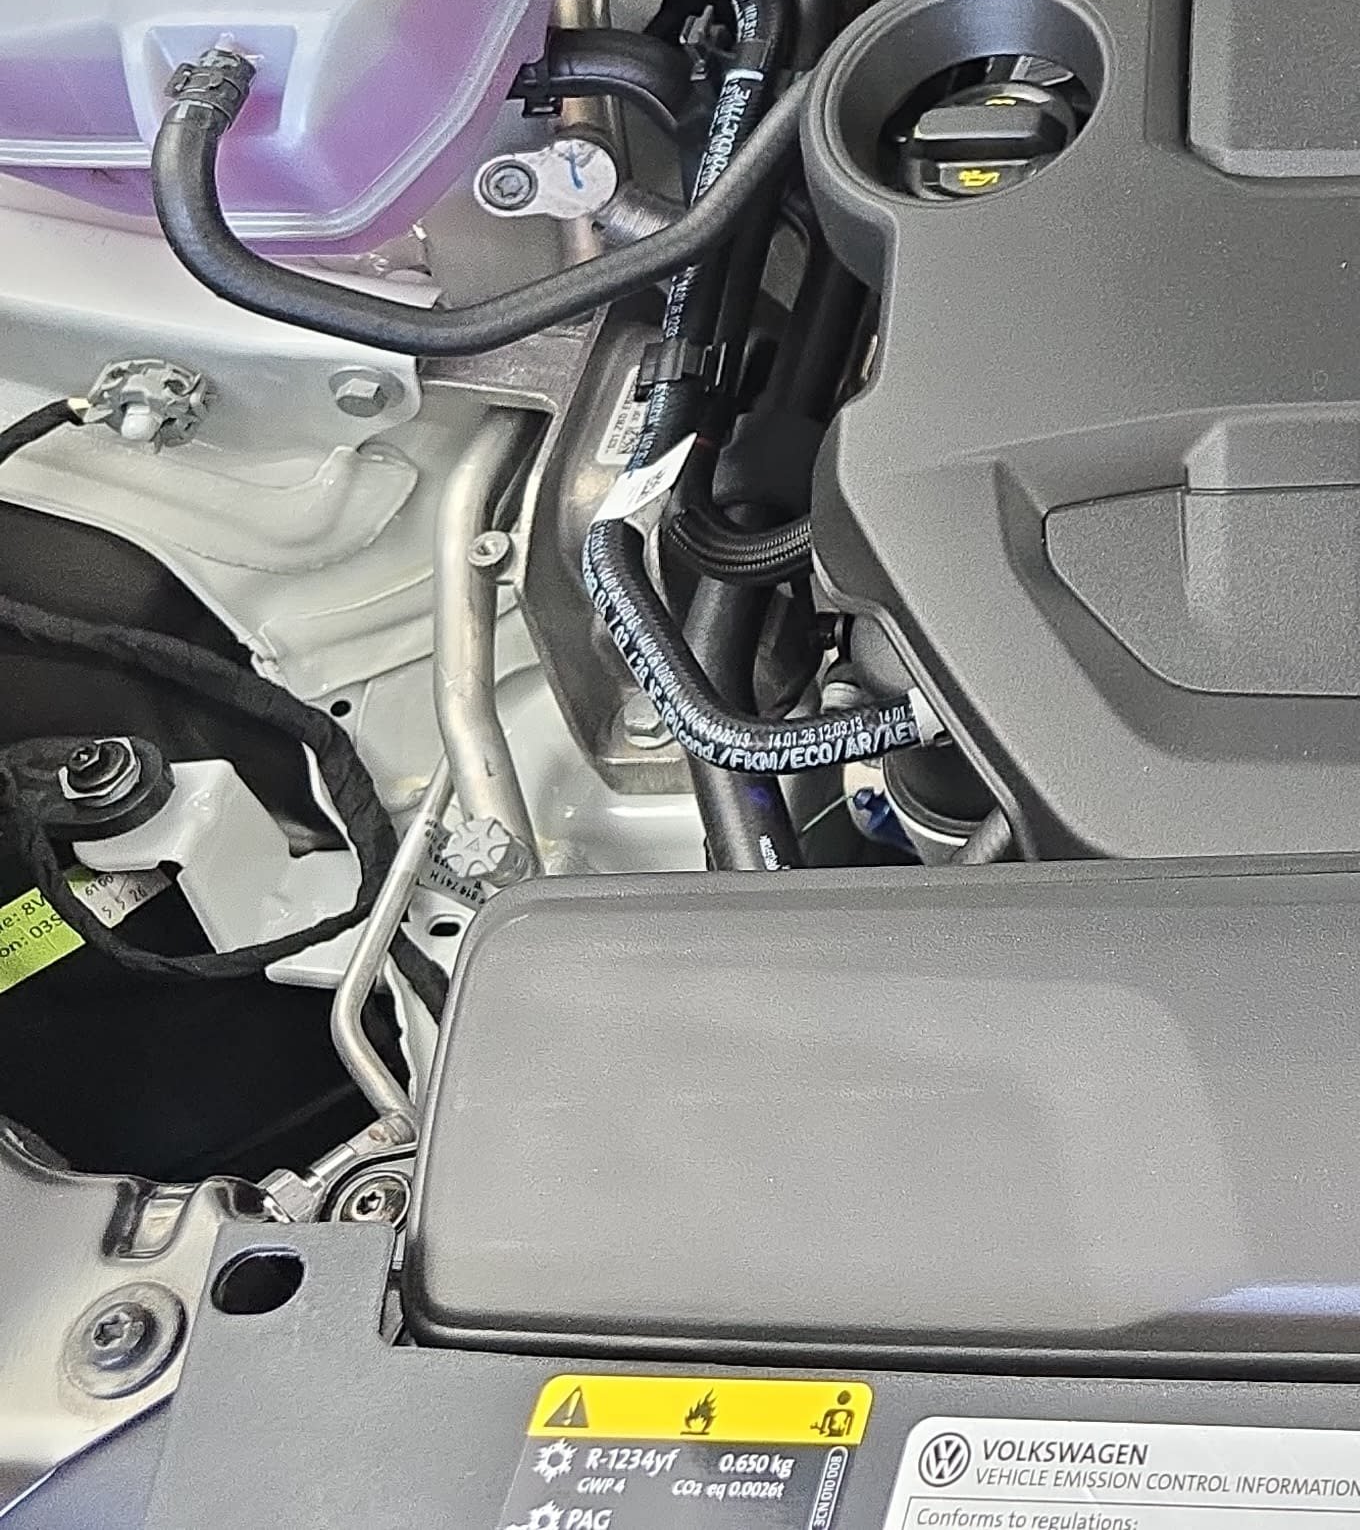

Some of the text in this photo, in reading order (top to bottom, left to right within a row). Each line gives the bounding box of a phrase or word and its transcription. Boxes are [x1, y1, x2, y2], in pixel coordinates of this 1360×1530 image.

[586, 1448, 795, 1479] R-1234yf 0.650 kg
[982, 1439, 1149, 1466] VOLKSWAGEN
[577, 1477, 613, 1494] GWP
[614, 1478, 626, 1494] 4
[708, 1482, 726, 1501] eq
[975, 1469, 1048, 1488] VEHICLE
[1053, 1470, 1140, 1490] EMISSION
[1146, 1473, 1229, 1493] CONTROL
[566, 1508, 612, 1530] PAG
[917, 1507, 1139, 1530] Conforms to regulations:
